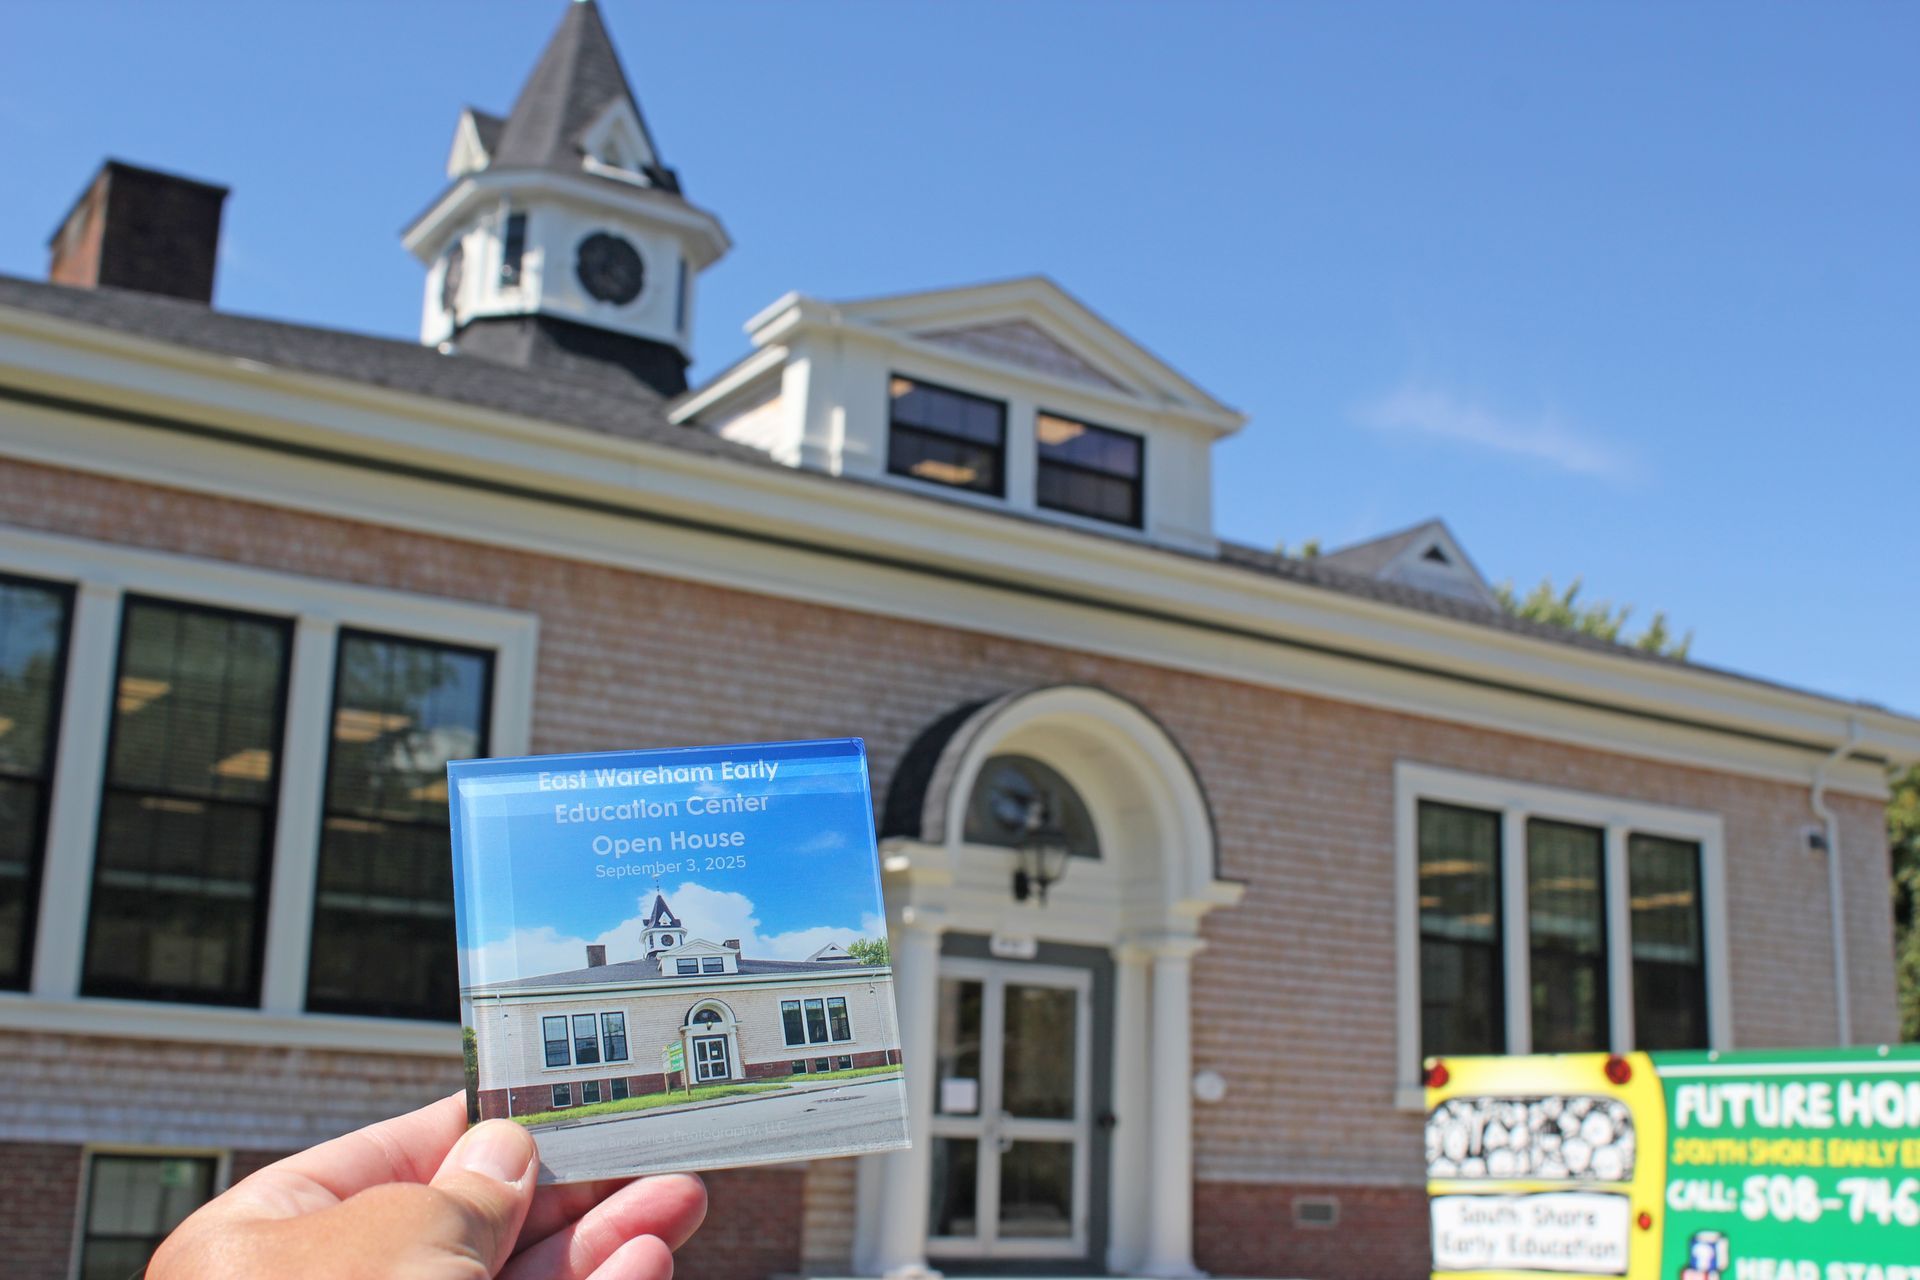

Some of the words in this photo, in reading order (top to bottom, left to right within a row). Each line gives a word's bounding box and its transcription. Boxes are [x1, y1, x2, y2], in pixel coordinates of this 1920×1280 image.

[538, 769, 587, 791] East
[594, 765, 713, 788] Wareham
[721, 759, 779, 782] Early
[555, 799, 678, 824] Education
[686, 793, 769, 816] Center
[592, 834, 662, 858] Open
[670, 830, 746, 850] House
[595, 861, 681, 880] September
[686, 859, 700, 873] 3,
[705, 855, 746, 871] 2025
[1674, 1081, 1835, 1129] FUTURE
[1672, 1137, 1748, 1166] SOUTH
[1749, 1137, 1826, 1167] SHORE
[1666, 1178, 1737, 1212] CALL:
[1459, 1202, 1521, 1225] South
[1532, 1203, 1599, 1228] Shore
[1442, 1231, 1497, 1261] Early
[1507, 1232, 1618, 1259] Education
